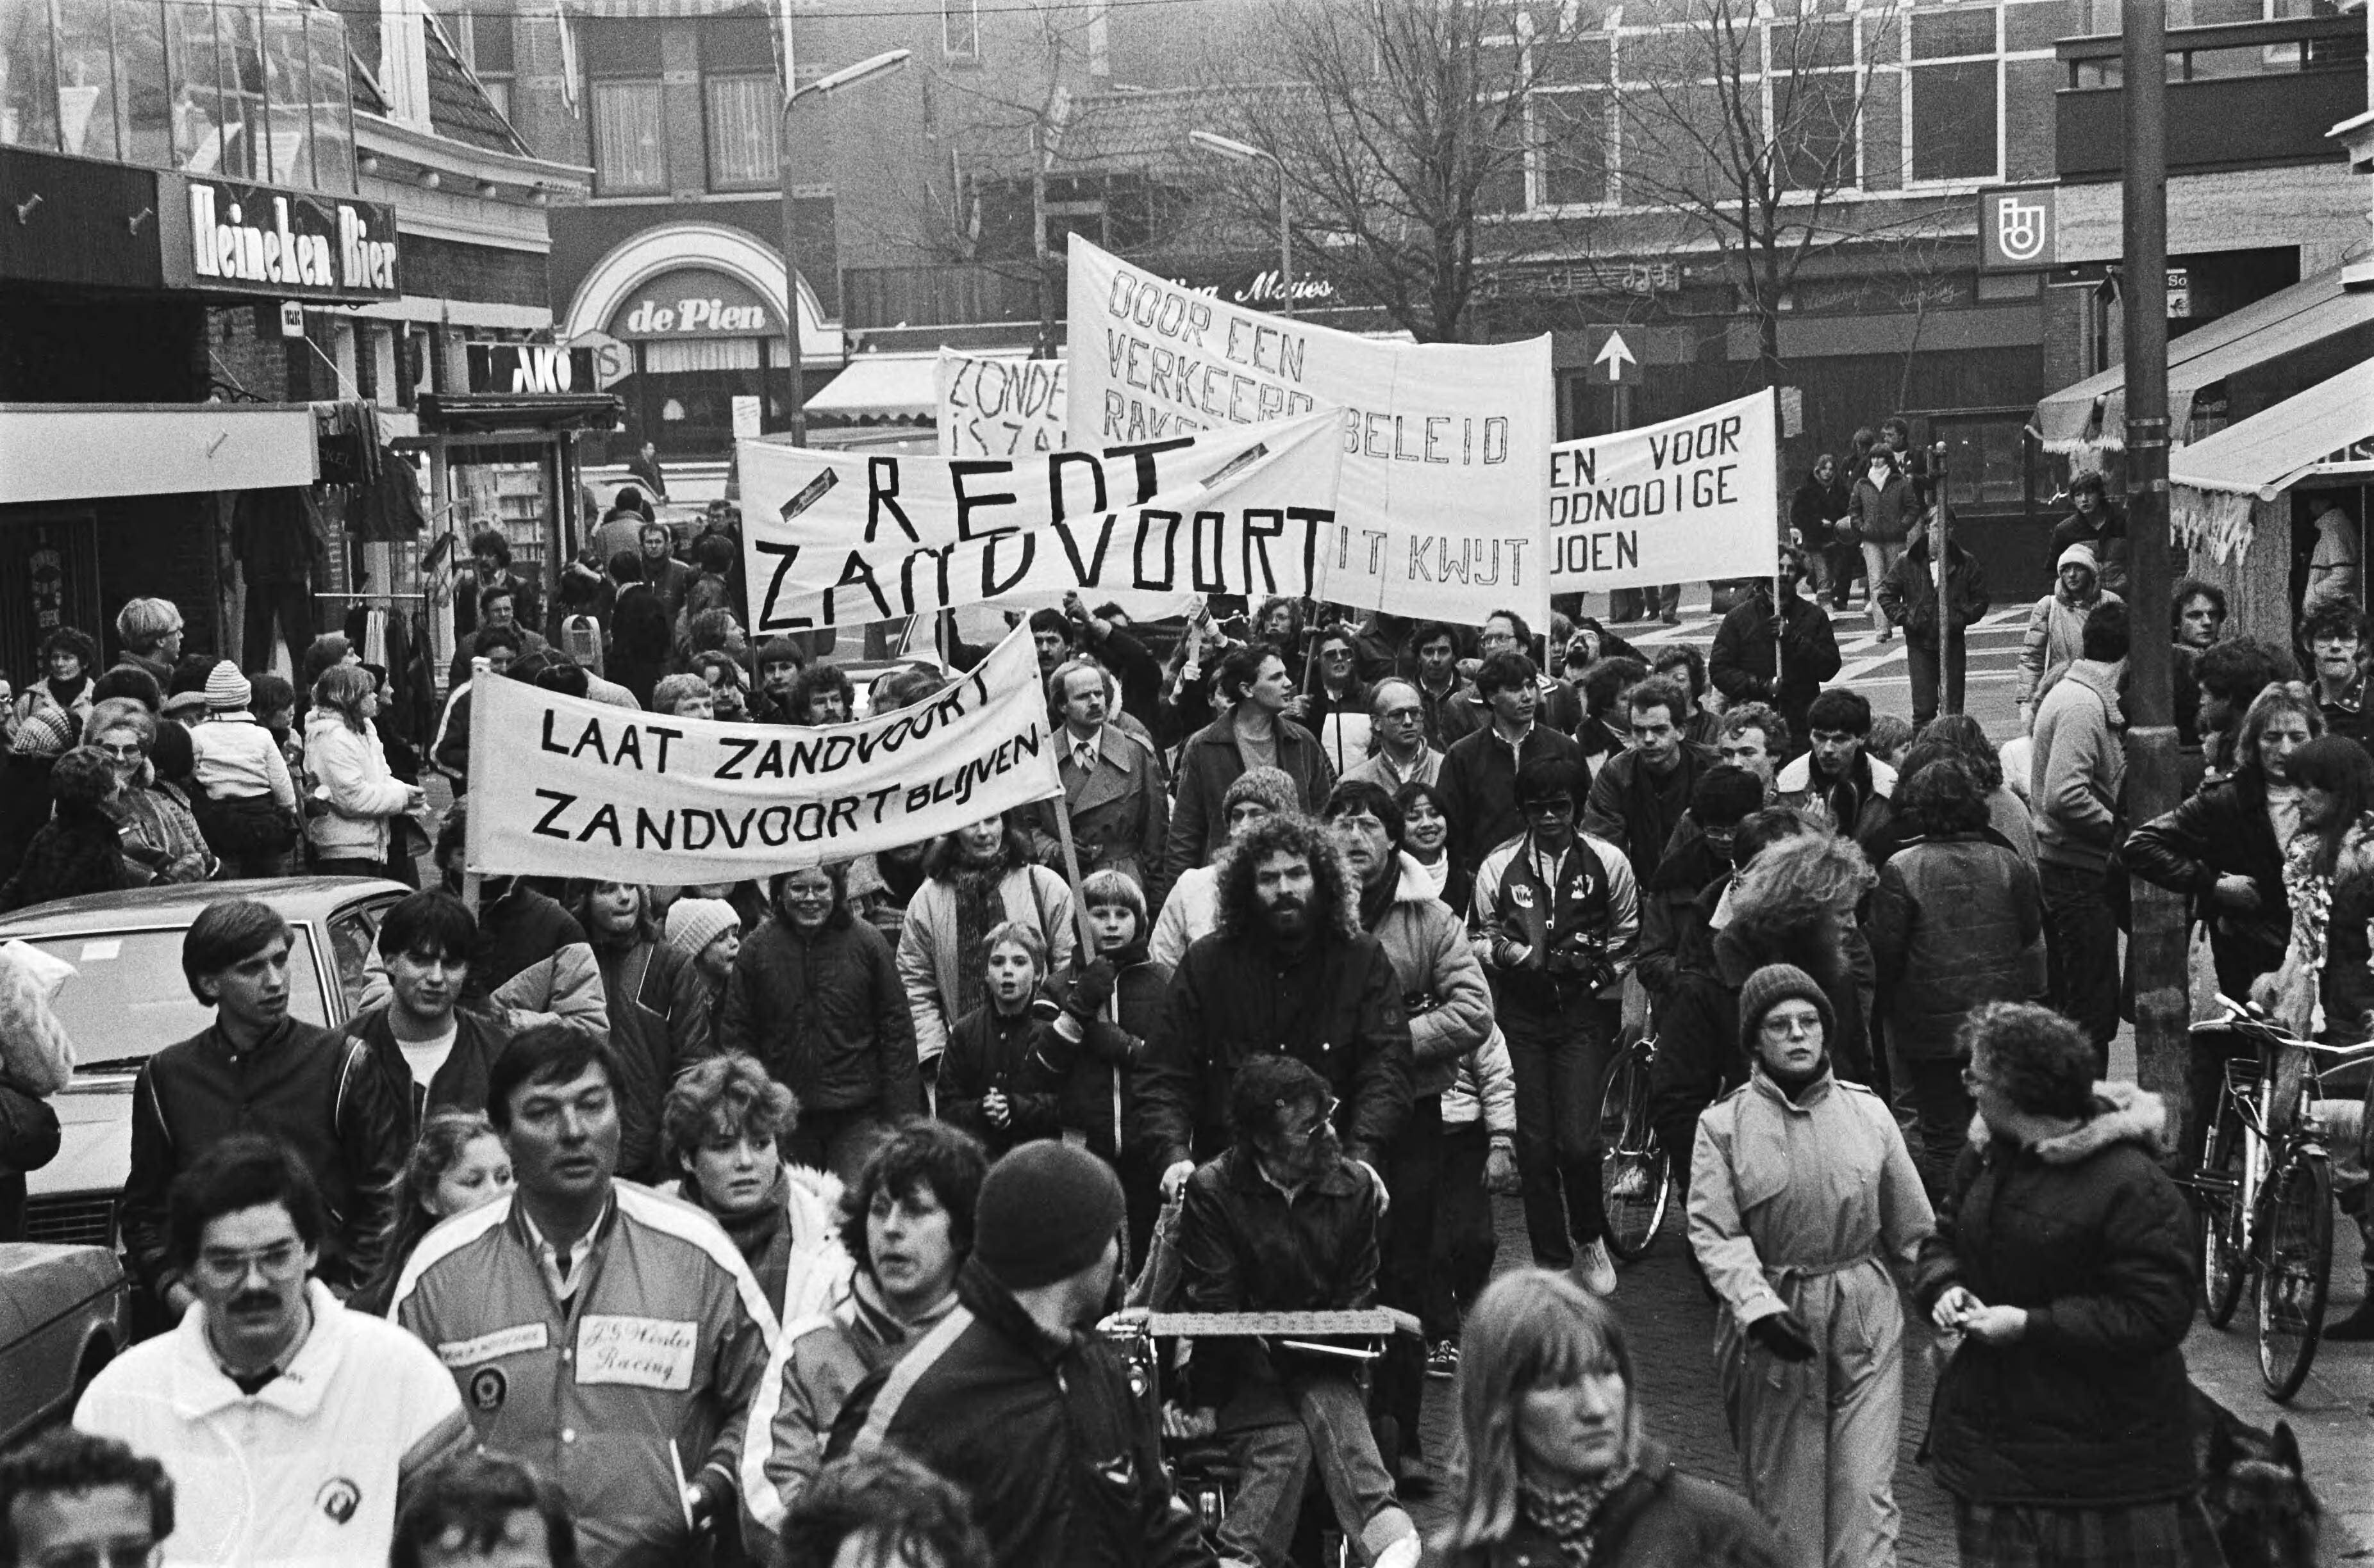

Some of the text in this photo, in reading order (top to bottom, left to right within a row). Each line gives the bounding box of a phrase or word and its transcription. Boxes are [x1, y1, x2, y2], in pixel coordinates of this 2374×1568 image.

[190, 183, 396, 289] Heineken Bier
[627, 298, 766, 333] de Pien
[1109, 269, 1305, 383] DOOR EEN
[512, 346, 572, 394] AKO
[1343, 407, 1508, 465] BELEID
[1550, 415, 1741, 488] EN VOOR
[864, 436, 1195, 543] REDT
[755, 506, 1336, 632] ZANDVOORT
[1408, 534, 1529, 586] KWIJT
[541, 660, 990, 780] LAAT ZANDVOORT
[532, 722, 1040, 851] ZANDVOORT BLIJVEN
[596, 1346, 674, 1383] Racing
